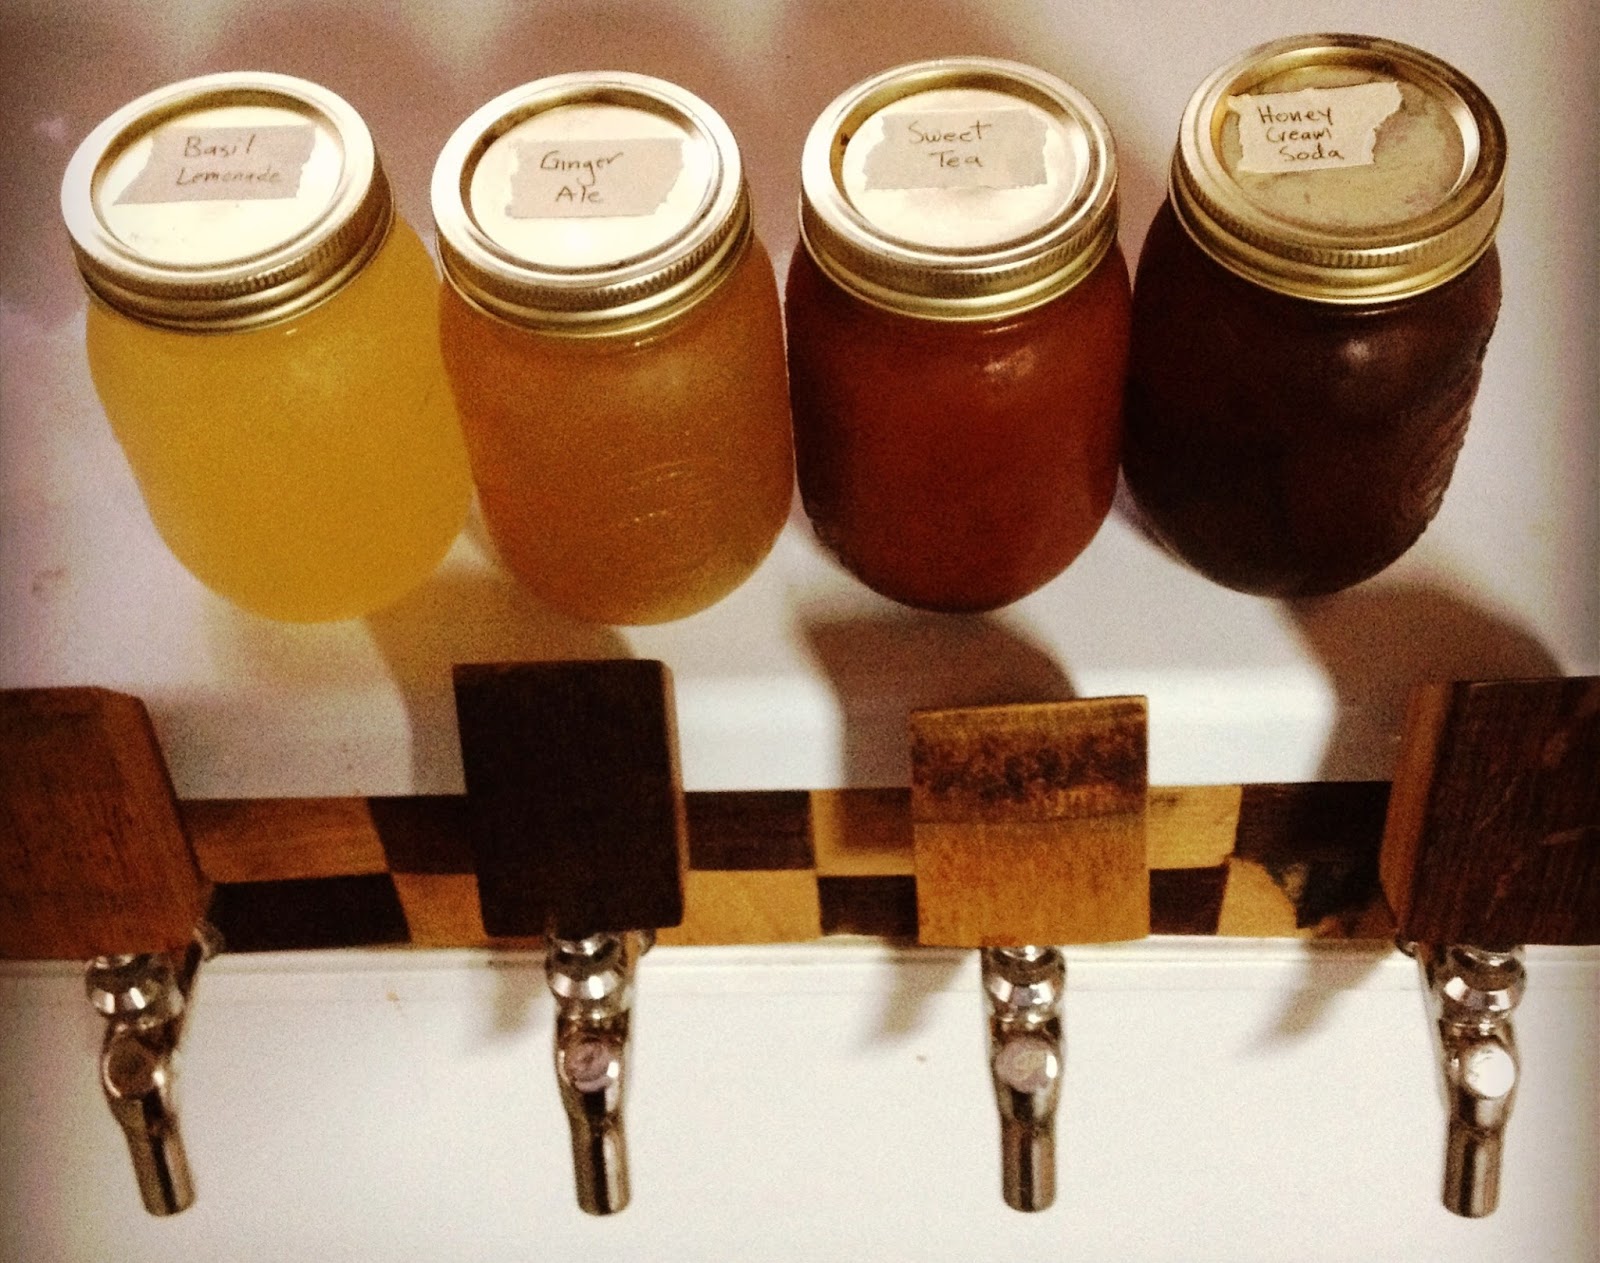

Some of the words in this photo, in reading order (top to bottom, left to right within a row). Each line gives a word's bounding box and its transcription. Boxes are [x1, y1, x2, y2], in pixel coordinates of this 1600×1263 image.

[1257, 105, 1333, 126] Honey
[908, 120, 992, 144] Sweet
[1266, 127, 1332, 143] Cream
[184, 134, 256, 158] Basil
[1279, 143, 1345, 162] Soda
[540, 150, 624, 187] Ginger
[930, 150, 984, 168] Tea
[176, 167, 282, 186] Lemonade
[555, 185, 603, 203] Ale
